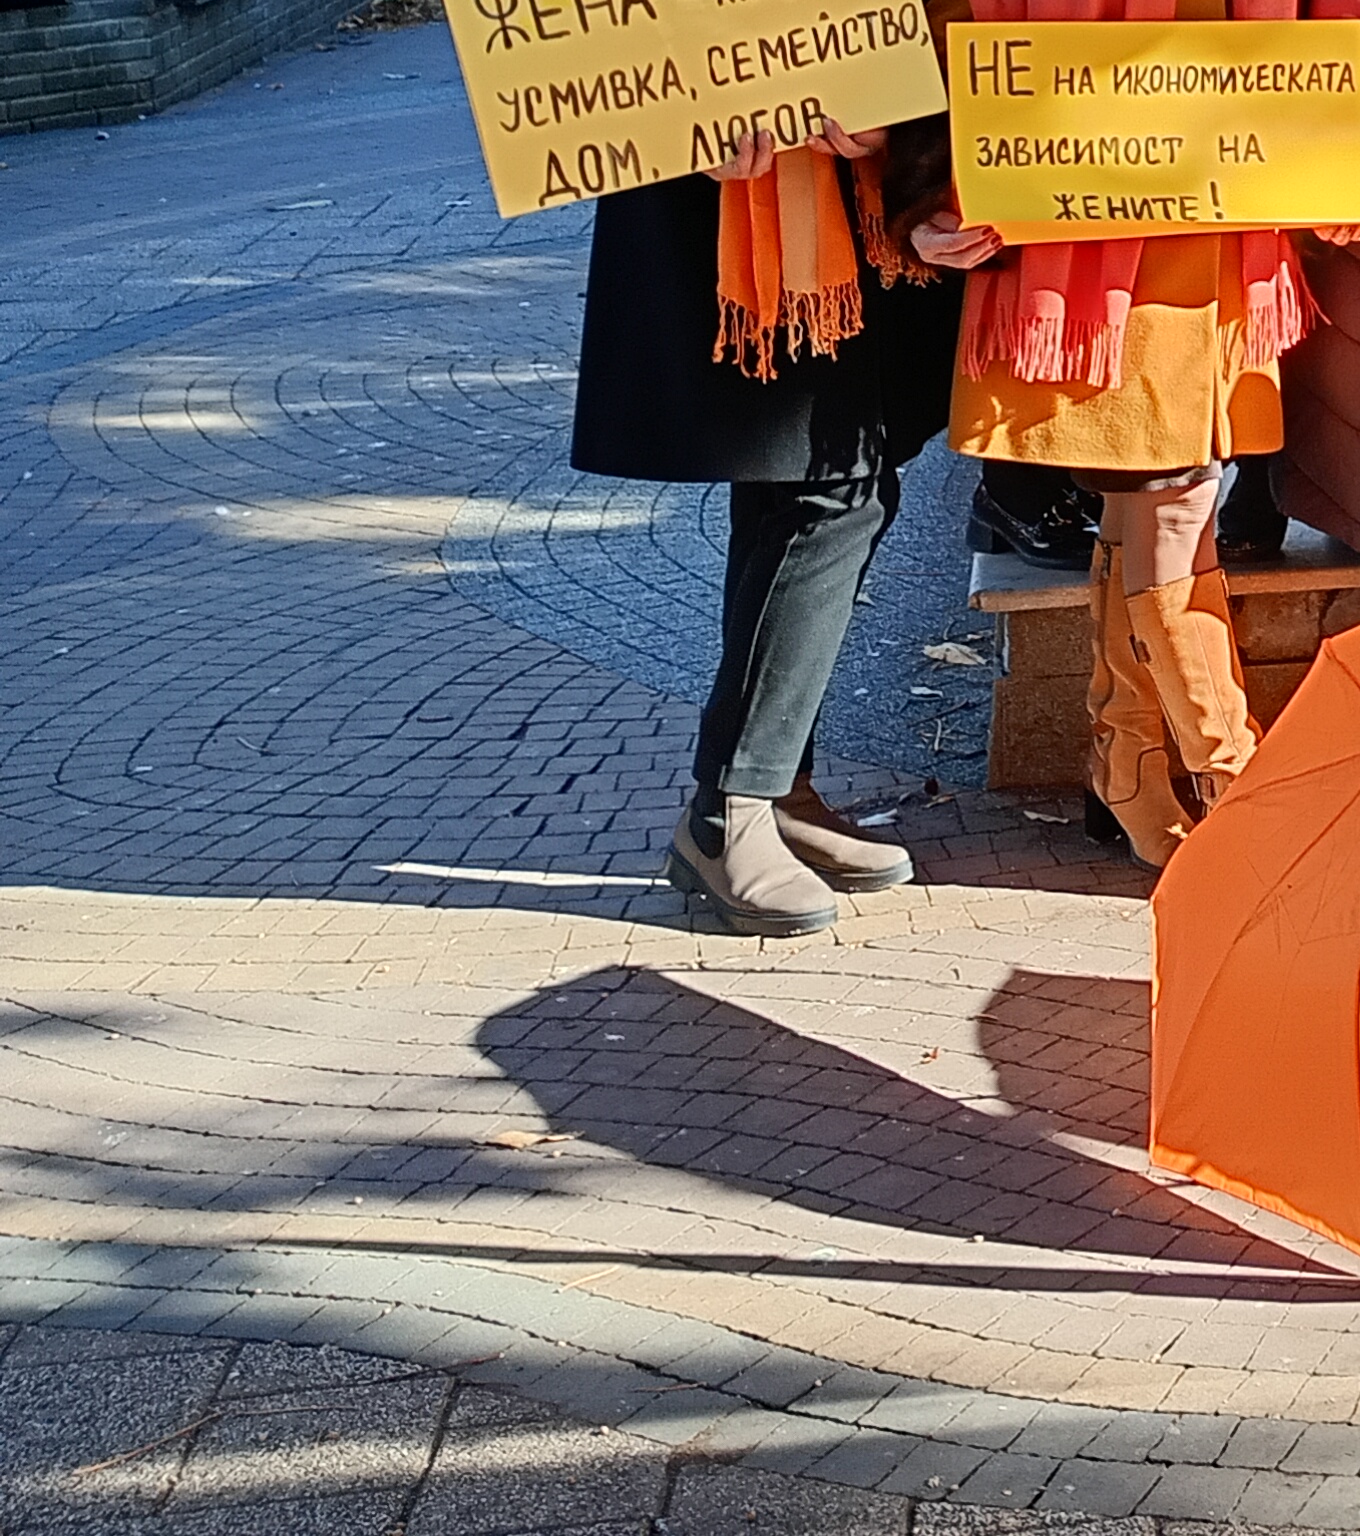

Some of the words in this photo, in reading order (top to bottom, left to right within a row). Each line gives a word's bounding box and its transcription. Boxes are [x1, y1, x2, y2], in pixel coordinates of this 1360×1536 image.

[497, 55, 698, 133] УСМИВКА,
[706, 1, 930, 87] СЕМЕЙСТВО,
[968, 39, 1035, 97] НЕ
[1054, 65, 1095, 95] НА
[1113, 62, 1356, 96] ИКОНОМИЧЕСКАТА
[975, 134, 1184, 168] ЗАВИСИМОСТ
[1218, 133, 1266, 164] НА
